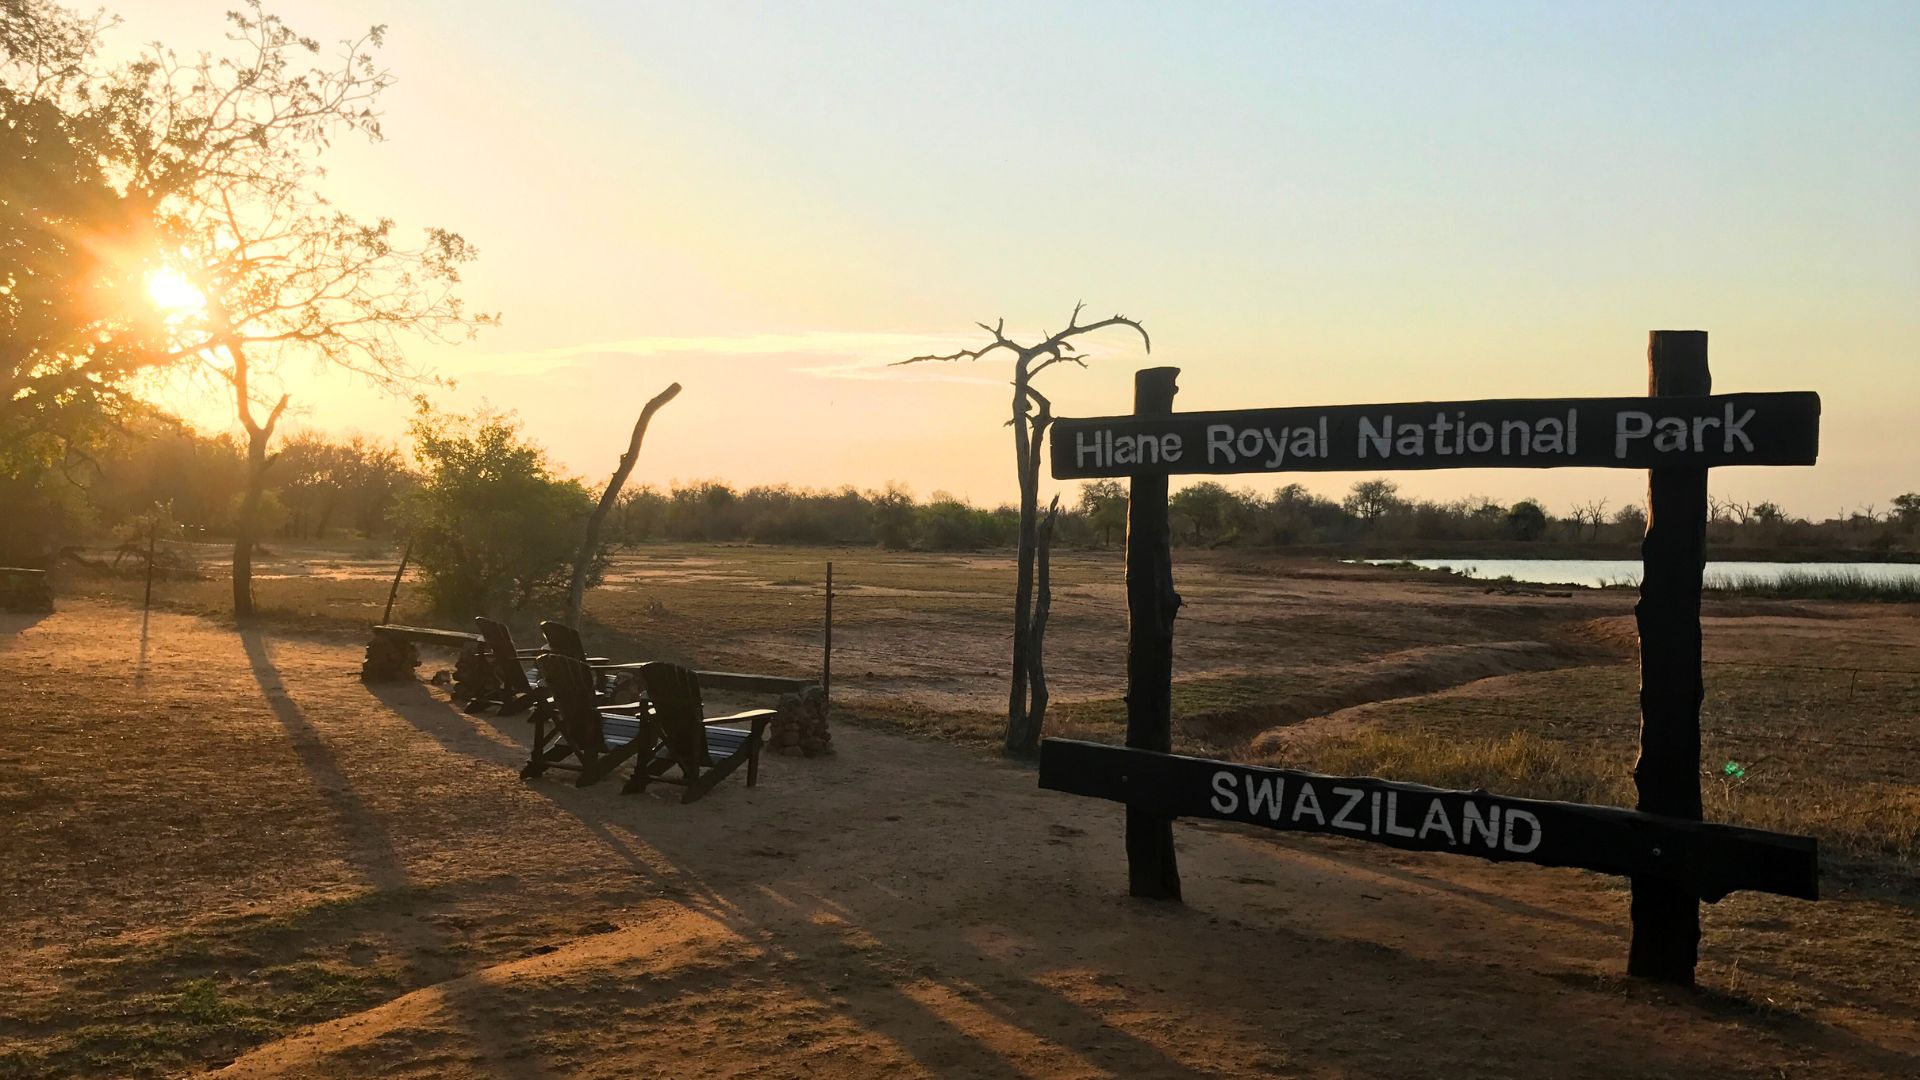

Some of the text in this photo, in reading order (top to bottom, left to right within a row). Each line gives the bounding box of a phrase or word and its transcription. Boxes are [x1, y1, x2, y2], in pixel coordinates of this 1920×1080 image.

[1076, 402, 1756, 468] Hlane Royal National Park
[1210, 770, 1542, 853] SWAZILAND
